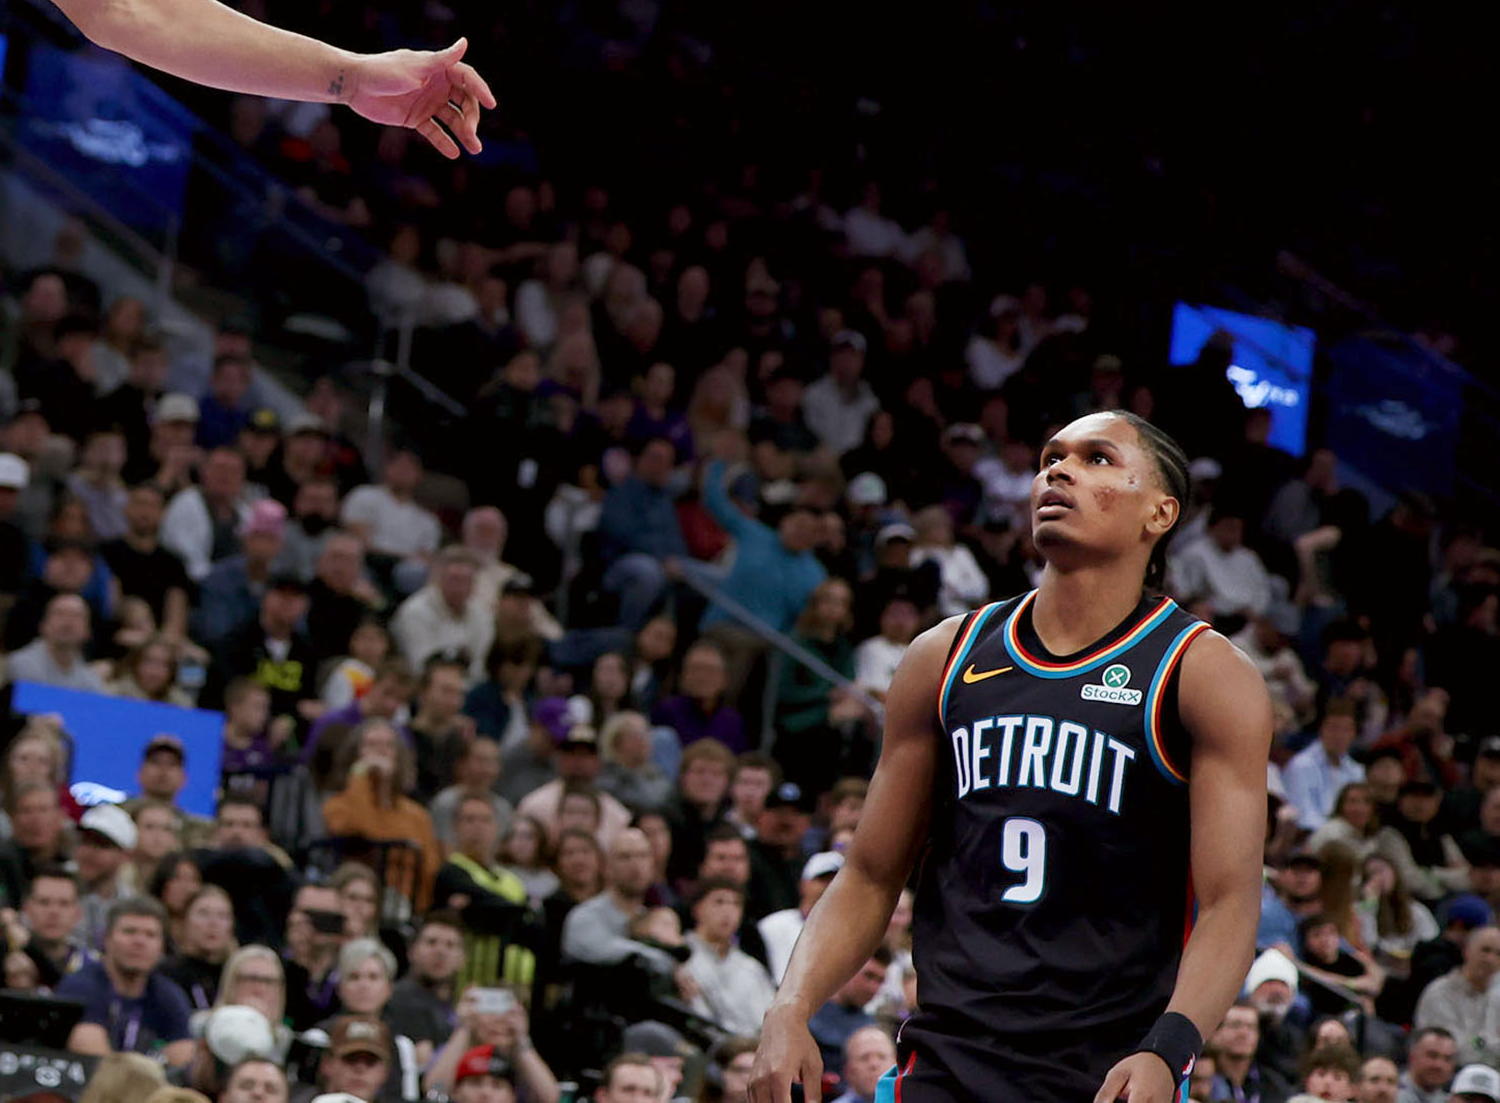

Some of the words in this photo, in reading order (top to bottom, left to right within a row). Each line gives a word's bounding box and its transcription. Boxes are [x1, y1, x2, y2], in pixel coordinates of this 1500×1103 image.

[1083, 686, 1140, 703] StockX
[951, 714, 1136, 816] DETROIT
[1001, 816, 1048, 904] 9
